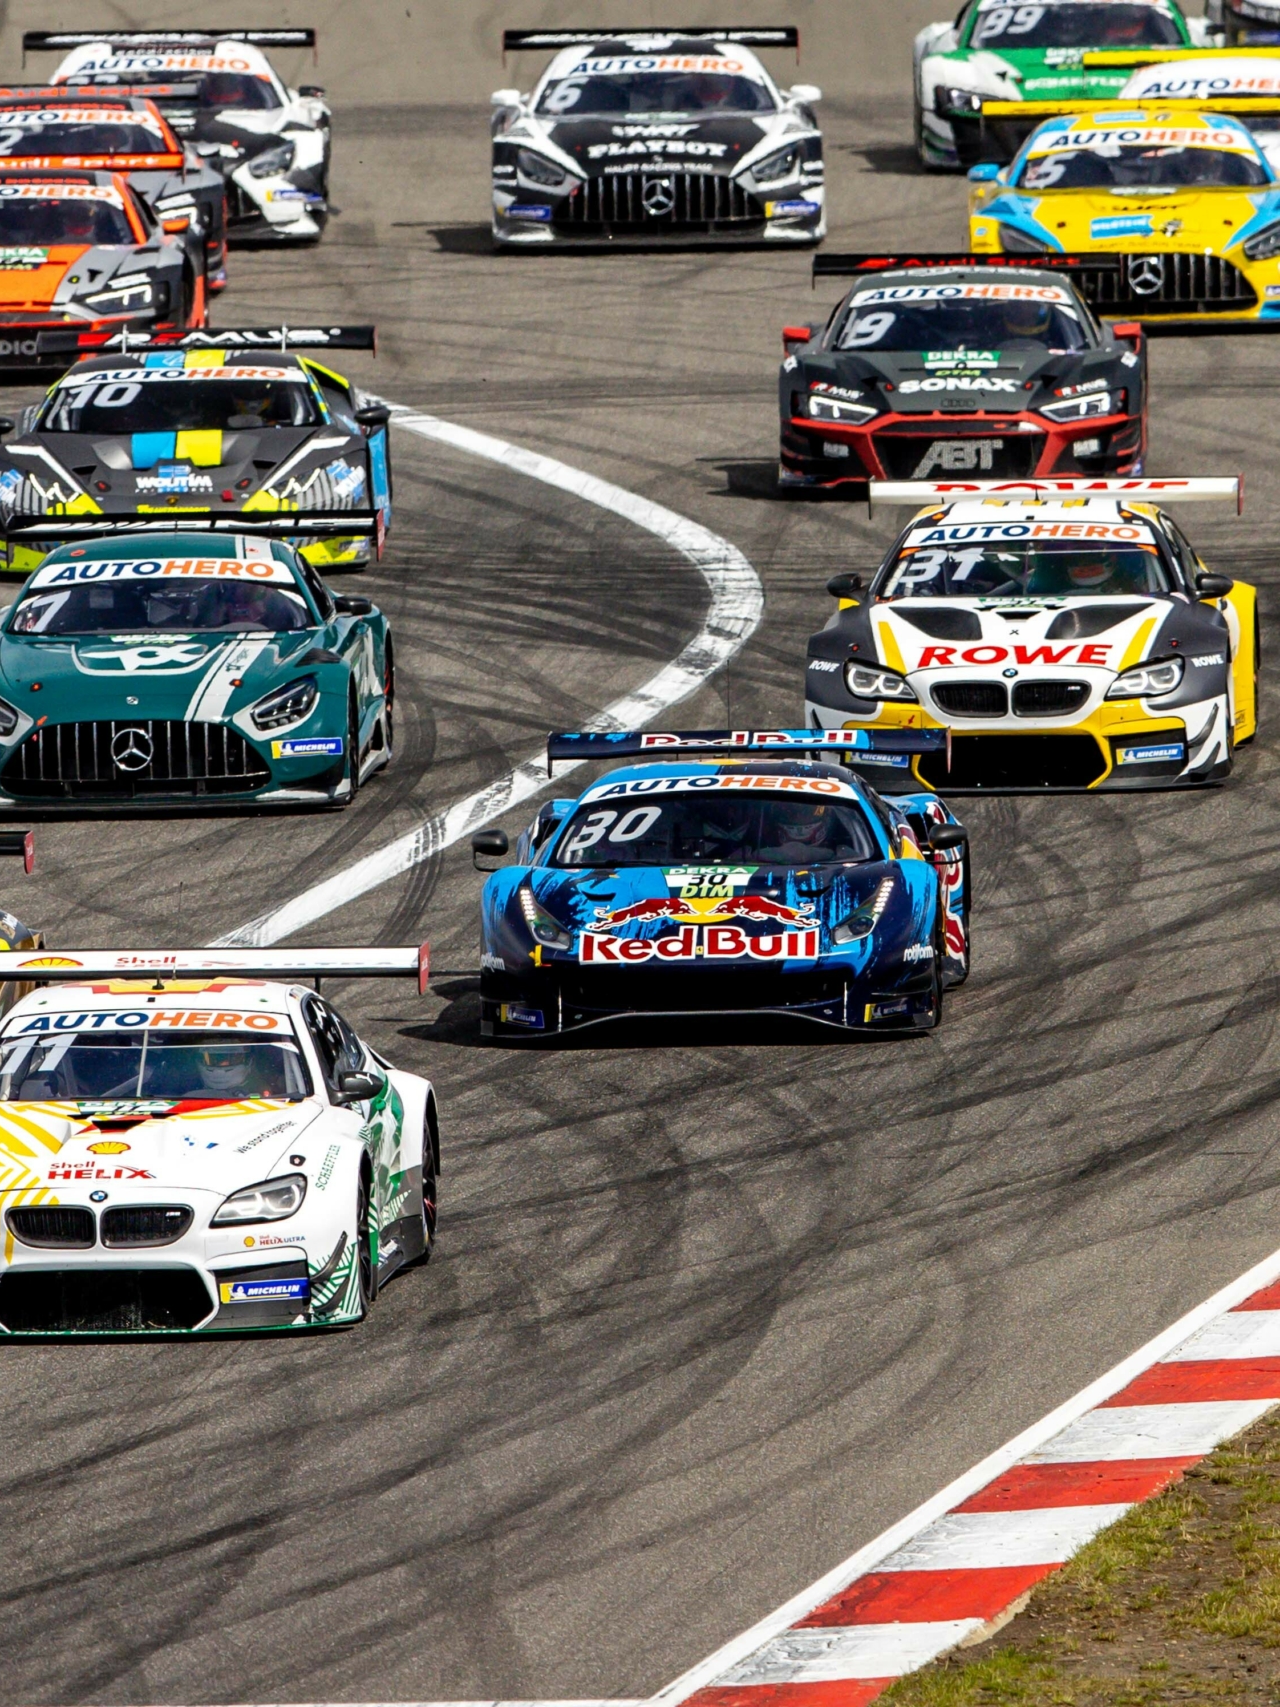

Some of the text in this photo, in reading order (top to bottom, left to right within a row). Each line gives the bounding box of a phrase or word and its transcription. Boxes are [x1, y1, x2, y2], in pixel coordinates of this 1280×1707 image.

[980, 4, 1046, 39] 99
[77, 56, 250, 73] AUTOHERO
[570, 57, 745, 74] AUTOHERO
[545, 76, 590, 112] 6
[1142, 77, 1280, 95] AUTOHE
[1048, 130, 1234, 148] AUTOHERO
[1024, 151, 1081, 188] 5
[865, 284, 1062, 301] AUTOHERO
[928, 351, 995, 361] DEKRA
[85, 369, 286, 383] AUTOHERO
[898, 378, 1016, 394] SONAX
[68, 382, 142, 410] 10
[911, 440, 998, 480] ABT
[919, 524, 1141, 543] AUTOHERO
[49, 560, 274, 583] AUTOHERO
[898, 547, 985, 583] 31
[917, 644, 1113, 668] ROWE
[1191, 653, 1224, 668] ROWE
[809, 660, 841, 673] ROWE
[293, 742, 337, 754] MICHELIN
[1136, 748, 1179, 759] MICHELIN
[861, 753, 903, 763] MICHELIN
[598, 776, 841, 799] AUTOHERO
[570, 805, 662, 851] 30
[669, 866, 745, 875] DEKRA
[688, 874, 727, 886] 30
[680, 884, 734, 898] DTM
[580, 928, 820, 963] Red Bull
[117, 956, 177, 965] Shell
[19, 1012, 278, 1033] AUTOHERO
[1, 1033, 78, 1075] 11
[51, 1160, 96, 1170] Shell
[48, 1168, 151, 1180] HELIX
[283, 1235, 306, 1243] ULTRA
[247, 1284, 300, 1296] MICHELIN
